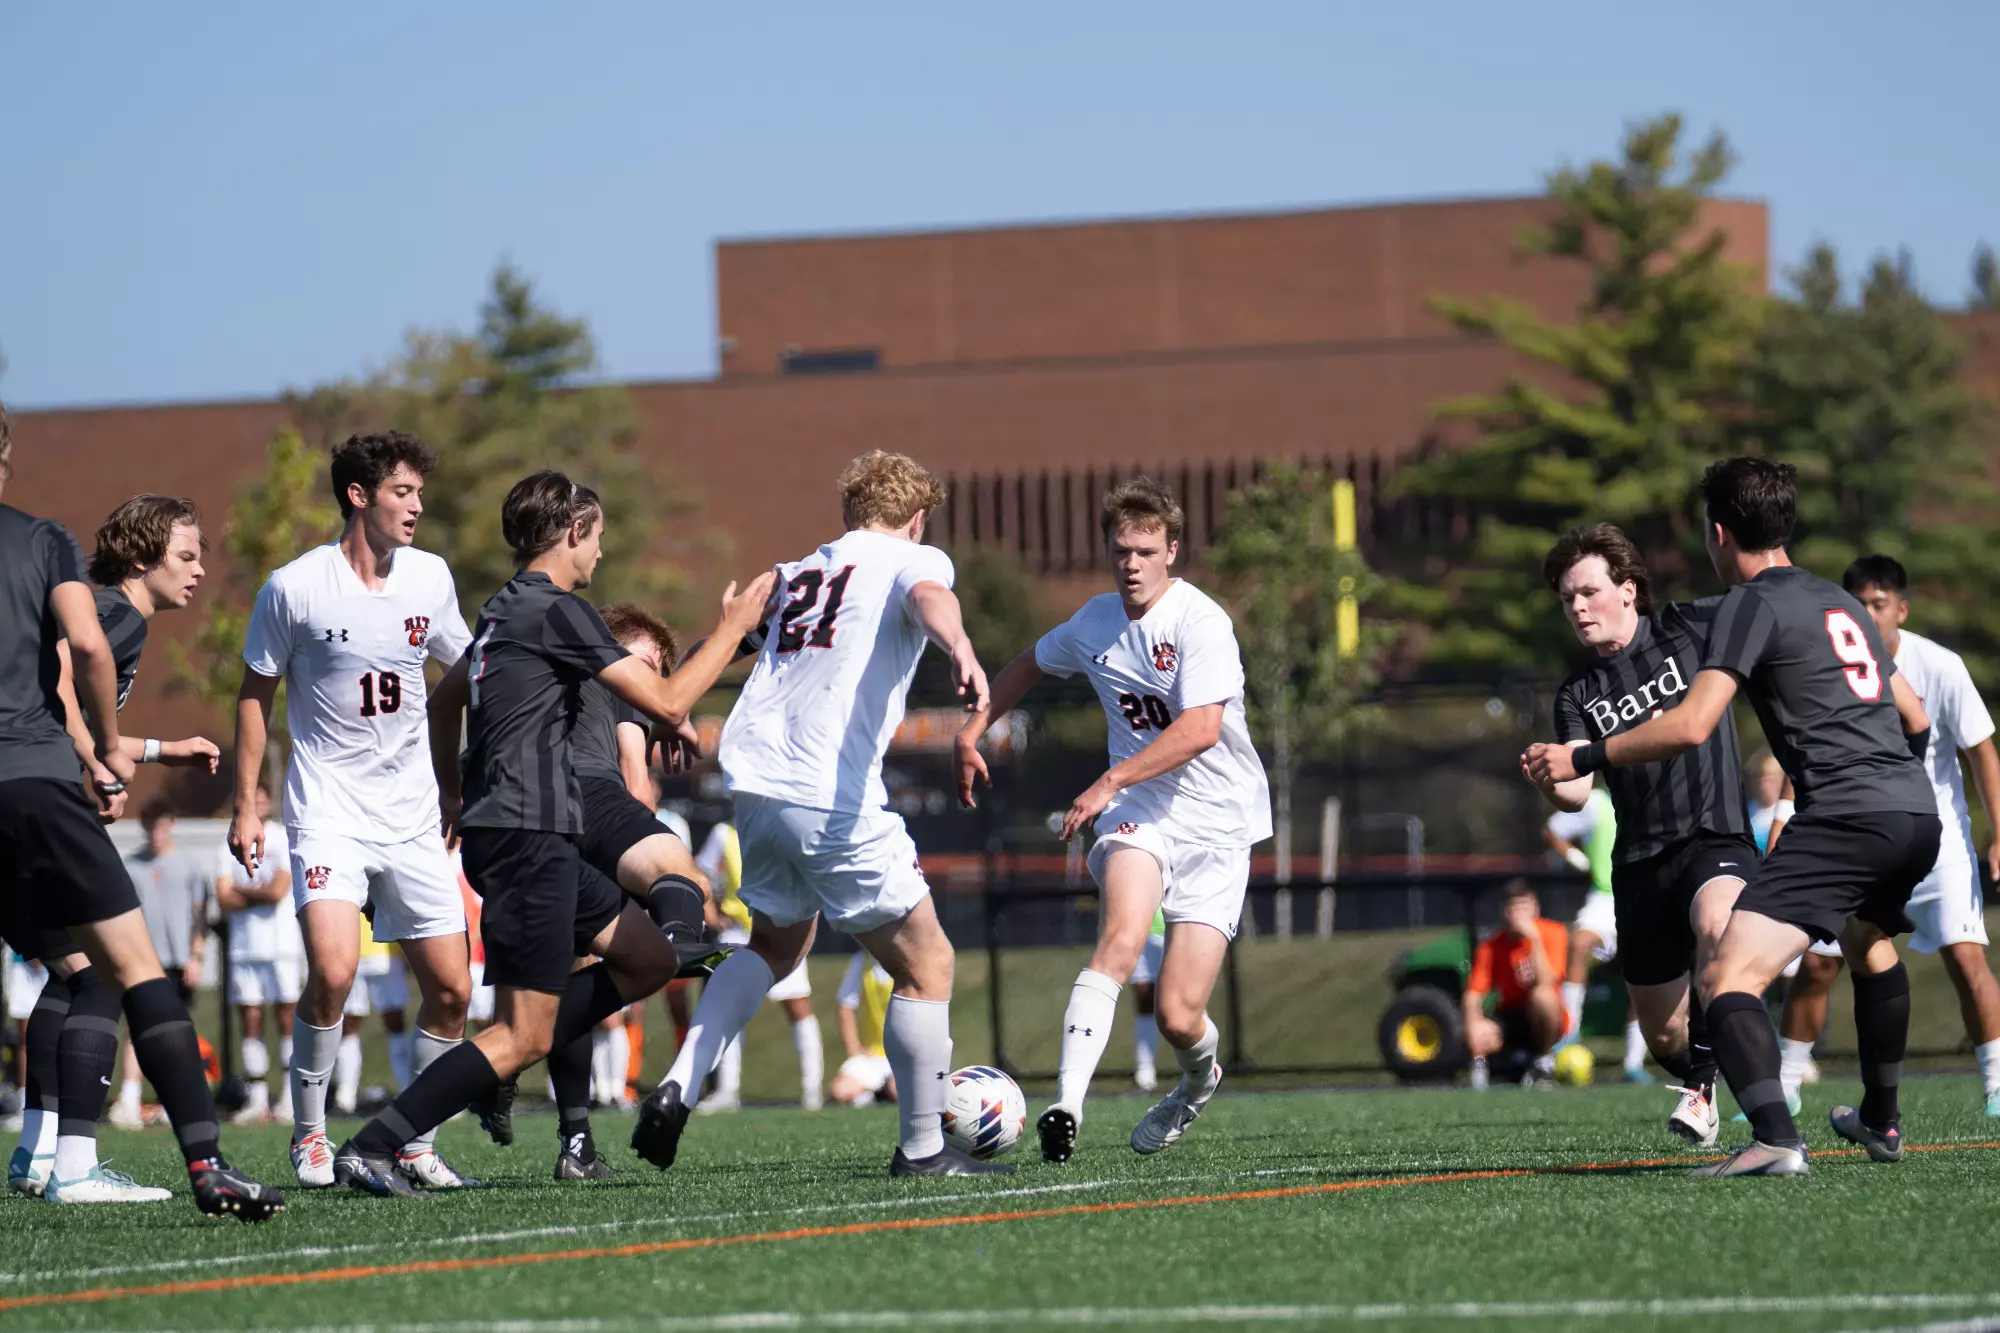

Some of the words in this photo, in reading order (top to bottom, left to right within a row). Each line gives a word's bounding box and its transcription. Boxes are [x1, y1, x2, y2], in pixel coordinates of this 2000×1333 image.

[404, 616, 430, 632] RIT
[776, 565, 857, 653] 21
[1825, 608, 1883, 702] 9
[359, 671, 401, 717] 19
[1119, 692, 1173, 731] 20
[1587, 656, 1688, 738] Bard
[305, 866, 332, 881] RIT
